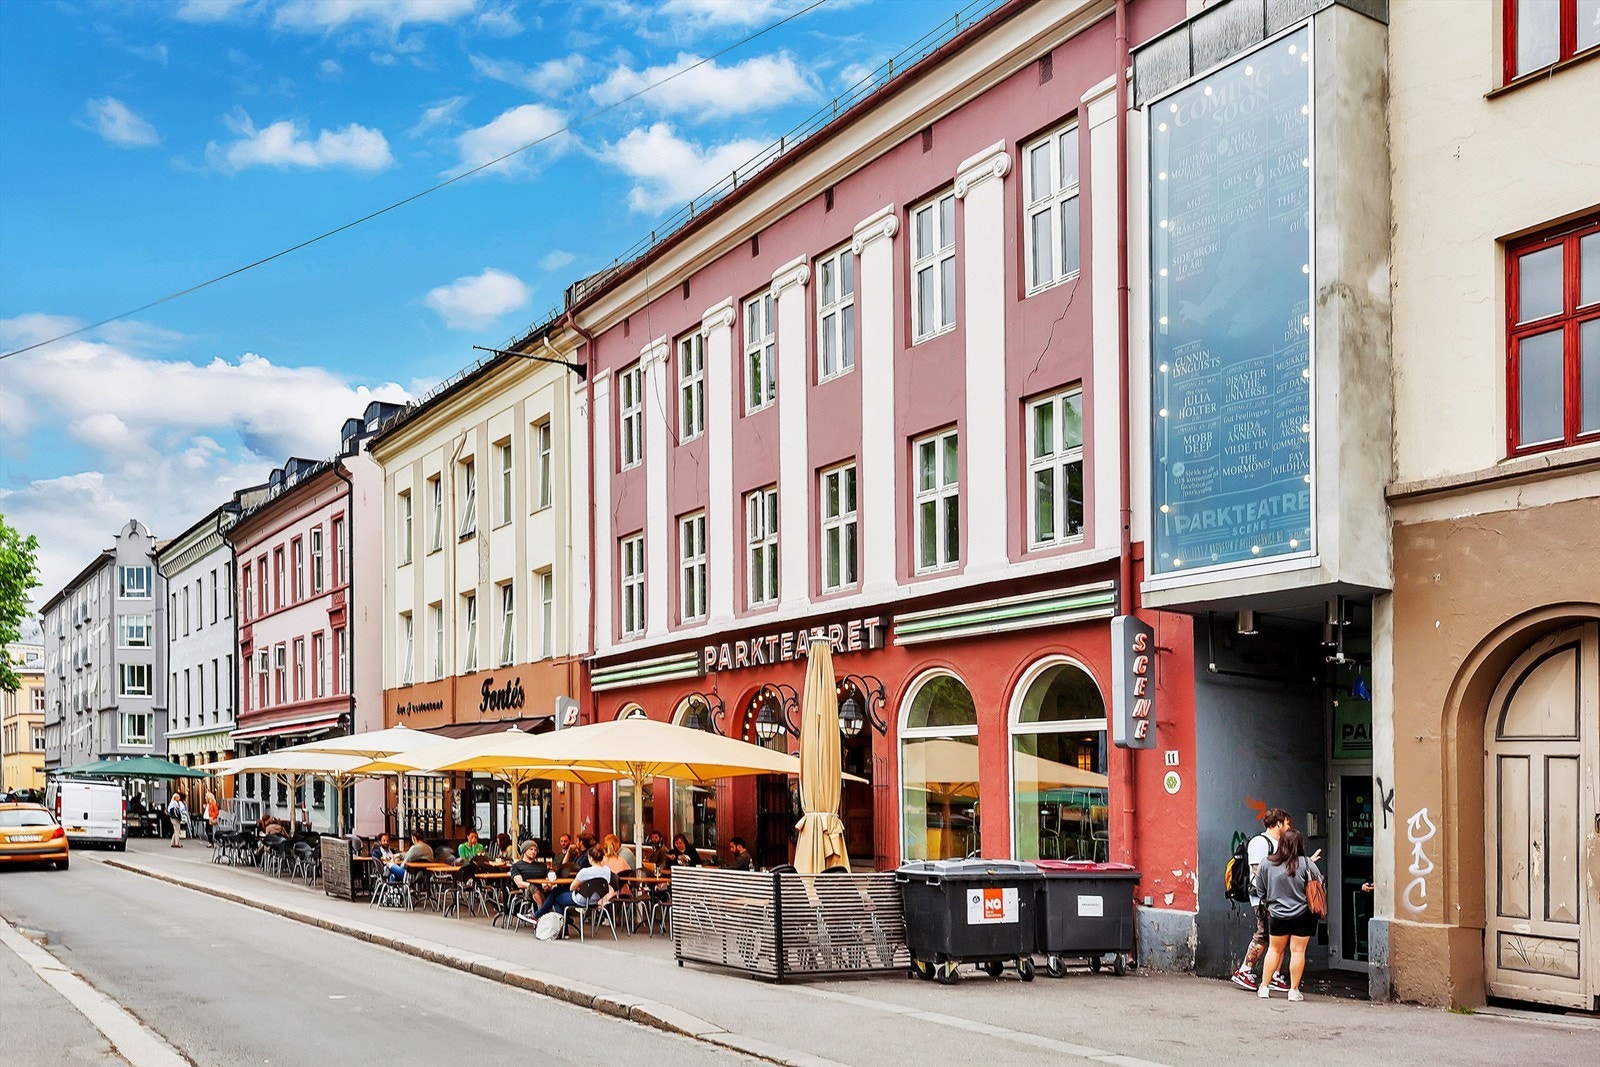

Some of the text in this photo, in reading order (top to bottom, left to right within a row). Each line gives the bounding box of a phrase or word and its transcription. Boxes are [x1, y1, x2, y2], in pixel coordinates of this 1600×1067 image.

[1175, 64, 1272, 127] COMING
[1212, 87, 1269, 128] SOON
[1276, 192, 1296, 208] THE
[1173, 251, 1191, 267] SIDE
[1193, 242, 1218, 258] BROK
[1175, 349, 1210, 368] CUNNIN
[1173, 356, 1220, 378] LYNGUISTS
[1226, 368, 1266, 386] DISASTER
[1242, 378, 1260, 390] THE
[1226, 385, 1267, 403] UNIVERSE
[1276, 382, 1287, 394] GET
[1184, 392, 1211, 408] JULIA
[1178, 402, 1217, 420] HOLTER
[1233, 420, 1261, 433] FRIDA
[1280, 414, 1308, 429] AUROR
[1183, 431, 1213, 445] MOBB
[1280, 425, 1304, 438] AKSN
[1185, 441, 1212, 454] DEEP
[1224, 438, 1270, 456] VILDE TUV
[1239, 454, 1257, 464] THE
[1289, 451, 1304, 463] FAY
[1222, 458, 1270, 477] MORMONES
[1232, 520, 1267, 536] SCENE
[1132, 632, 1152, 740] SCENE
[479, 677, 525, 713] Fontés
[1342, 723, 1372, 740] PA
[1167, 753, 1176, 763] 11
